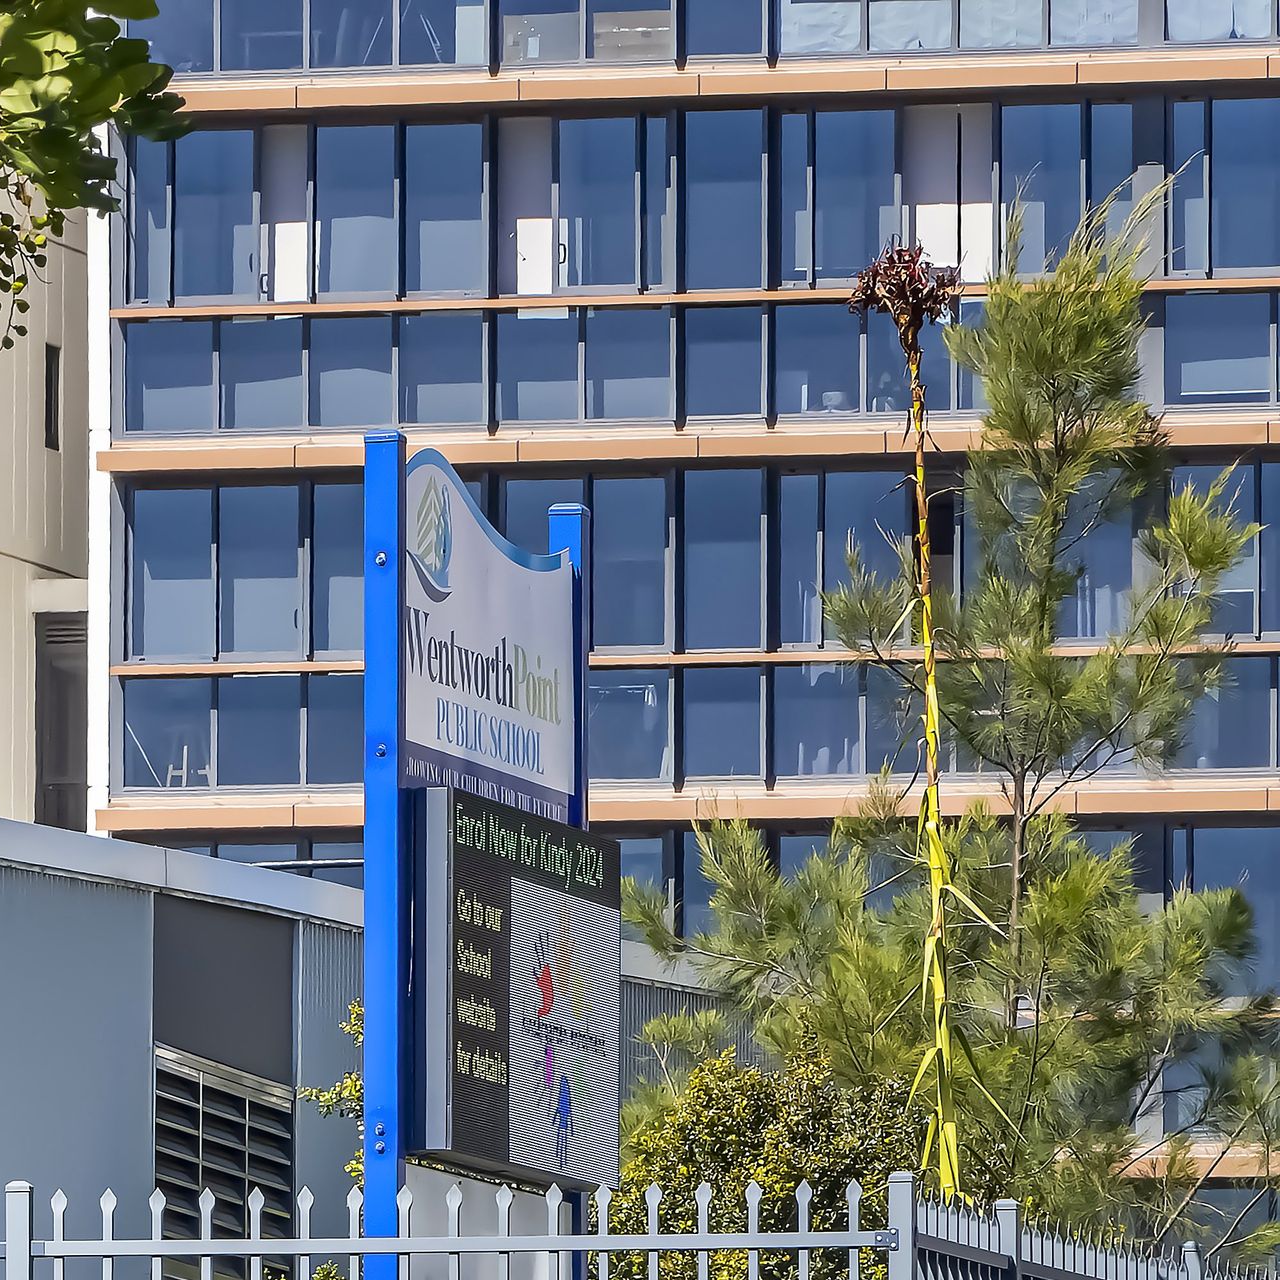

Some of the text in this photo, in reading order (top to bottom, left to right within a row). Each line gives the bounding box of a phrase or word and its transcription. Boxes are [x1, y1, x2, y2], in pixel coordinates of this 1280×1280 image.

[436, 697, 544, 776] PUBLIC SCHOOL
[406, 756, 441, 785] ROWING
[442, 767, 459, 789] OUR
[461, 773, 499, 803] CHILDREN
[501, 785, 516, 808] FOR
[517, 791, 532, 813] THE
[456, 802, 604, 891] Enrol Now for Kindy 2024
[457, 889, 504, 932] Go to our
[457, 939, 492, 979] School
[456, 994, 497, 1031] website
[456, 1041, 507, 1086] for details
